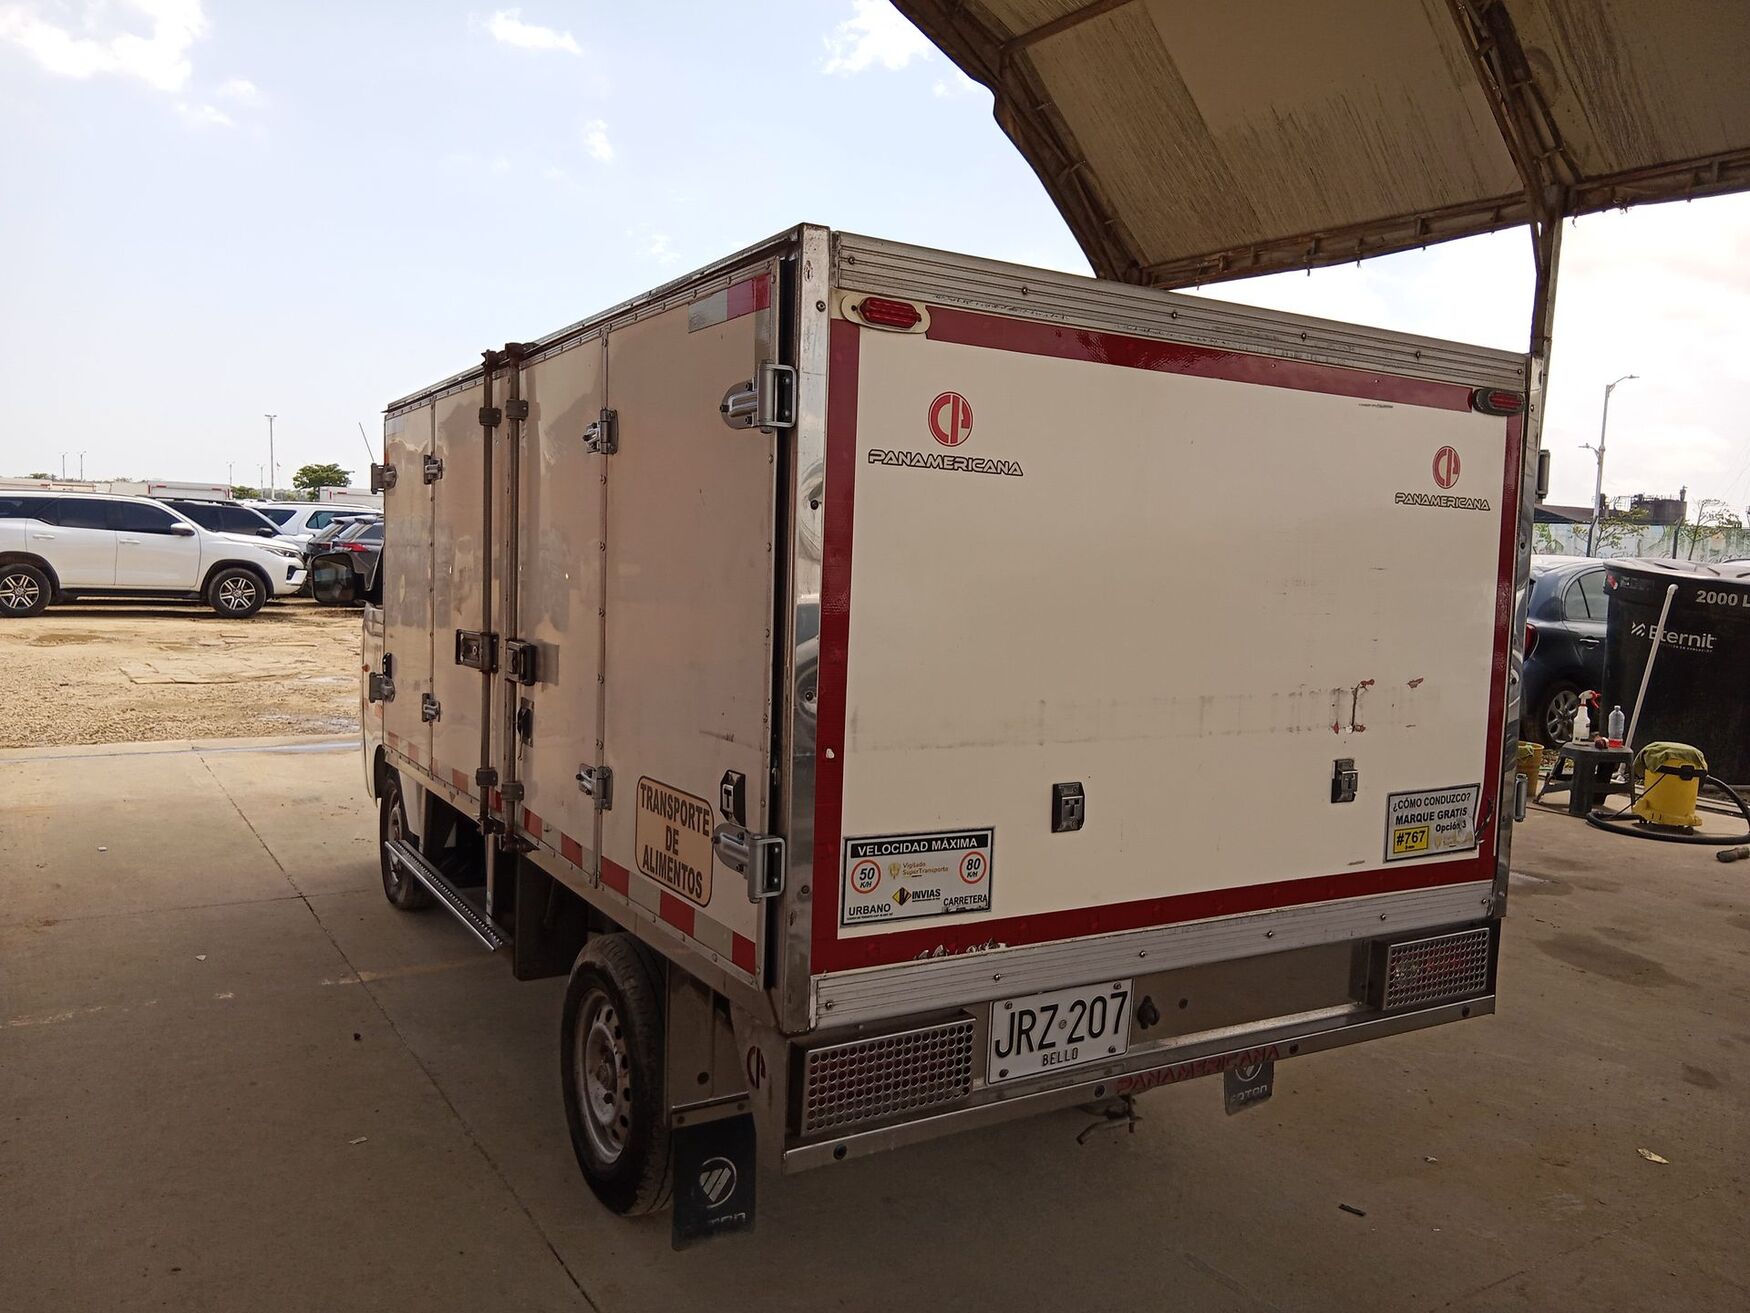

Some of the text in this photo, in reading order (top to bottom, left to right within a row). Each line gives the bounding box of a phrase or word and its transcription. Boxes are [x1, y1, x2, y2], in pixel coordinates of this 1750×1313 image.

[868, 449, 1024, 476] PANAMERICANA
[1395, 492, 1491, 511] PANAMERICANA
[1696, 590, 1739, 607] 2000
[640, 782, 710, 837] TRANSPORTE
[1392, 792, 1471, 812] ¿CÓMO CONDUZCO?
[1395, 807, 1468, 826] MARQUE GRATIS
[665, 825, 680, 856] DE
[858, 837, 978, 857] VELOCIDAD MÁXIMA
[1396, 830, 1426, 846] #767
[642, 844, 703, 899] ALIMENTOS
[966, 857, 981, 871] 80
[859, 867, 875, 881] 50
[912, 888, 941, 900] INVIAS
[944, 894, 988, 907] CARRETERA
[848, 904, 891, 917] URBANO
[1042, 1047, 1079, 1067] BELLO
